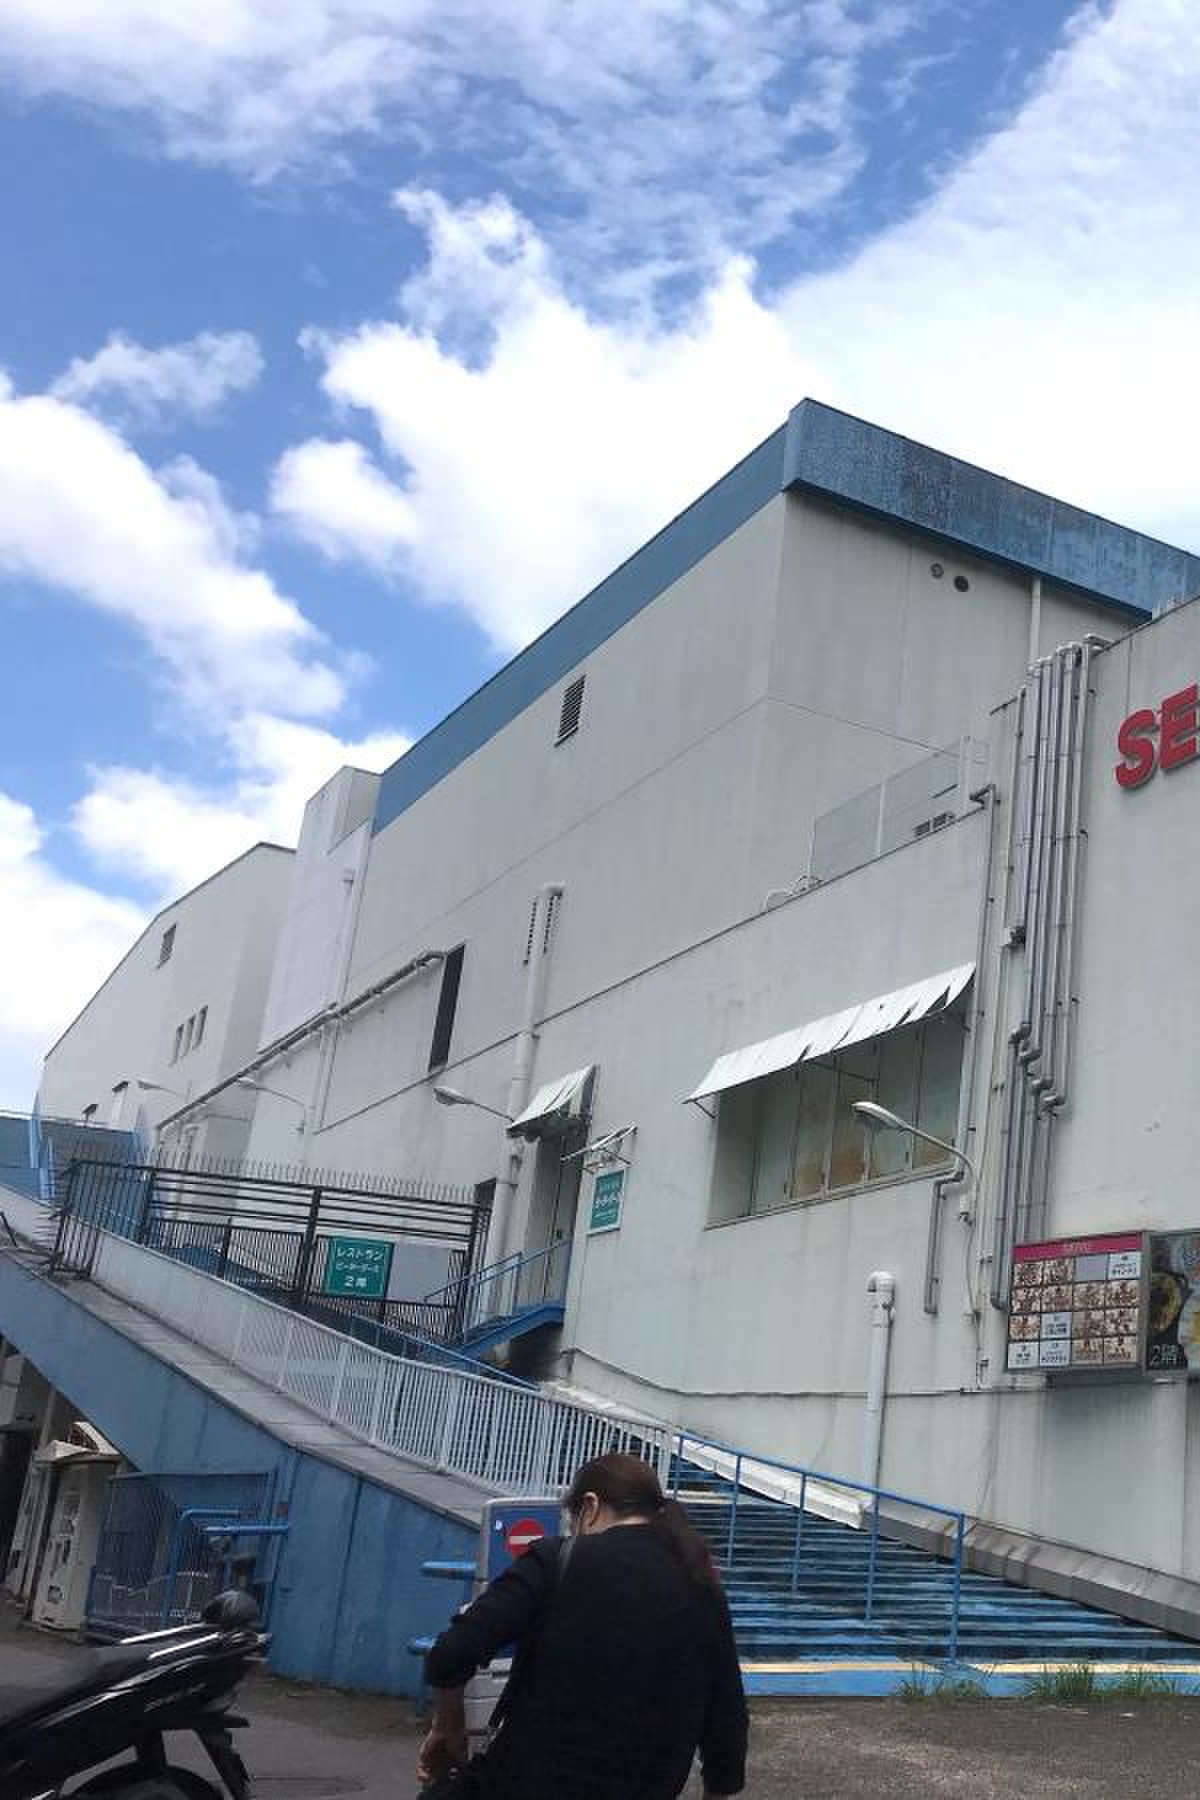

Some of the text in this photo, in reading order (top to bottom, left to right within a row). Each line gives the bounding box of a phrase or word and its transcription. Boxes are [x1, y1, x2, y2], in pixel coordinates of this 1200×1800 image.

[336, 1247, 384, 1262] レストラン
